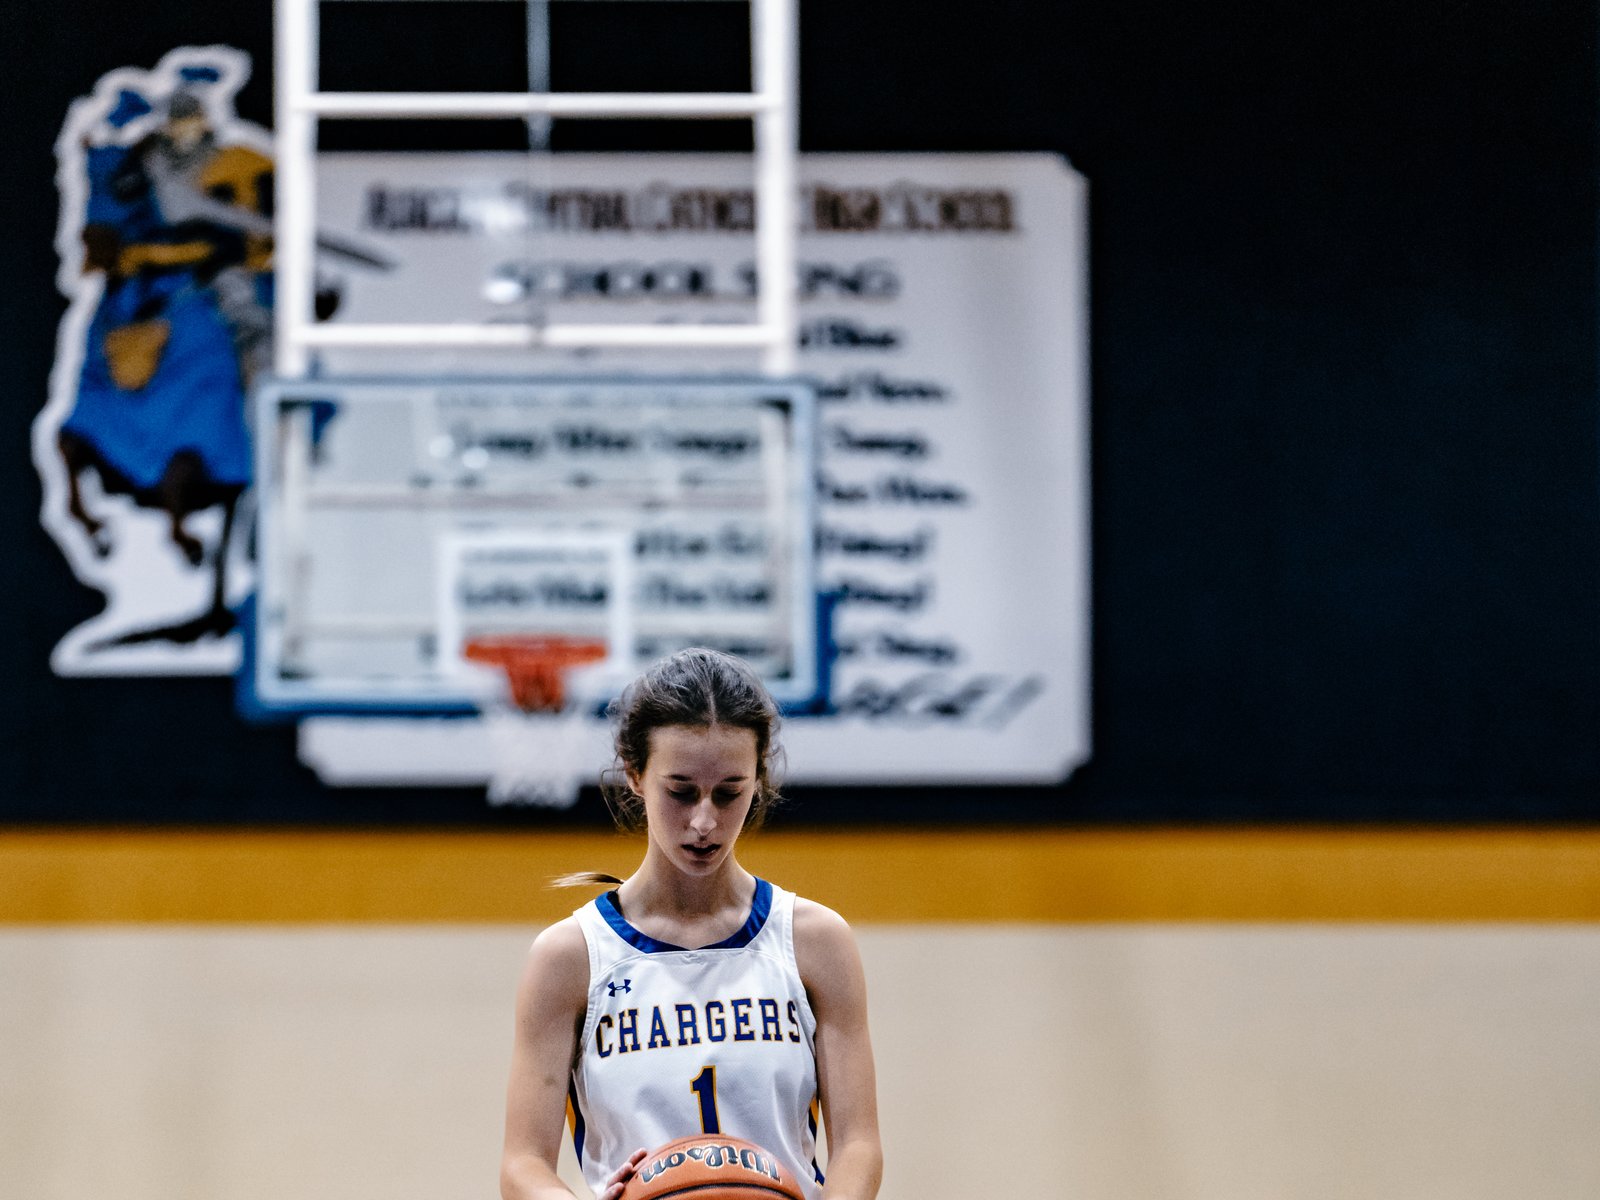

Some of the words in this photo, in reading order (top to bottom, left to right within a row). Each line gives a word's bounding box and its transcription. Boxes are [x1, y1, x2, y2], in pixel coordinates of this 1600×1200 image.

[596, 998, 801, 1058] CHARGERS
[690, 1065, 721, 1135] 1
[640, 1144, 783, 1184] Wilson
